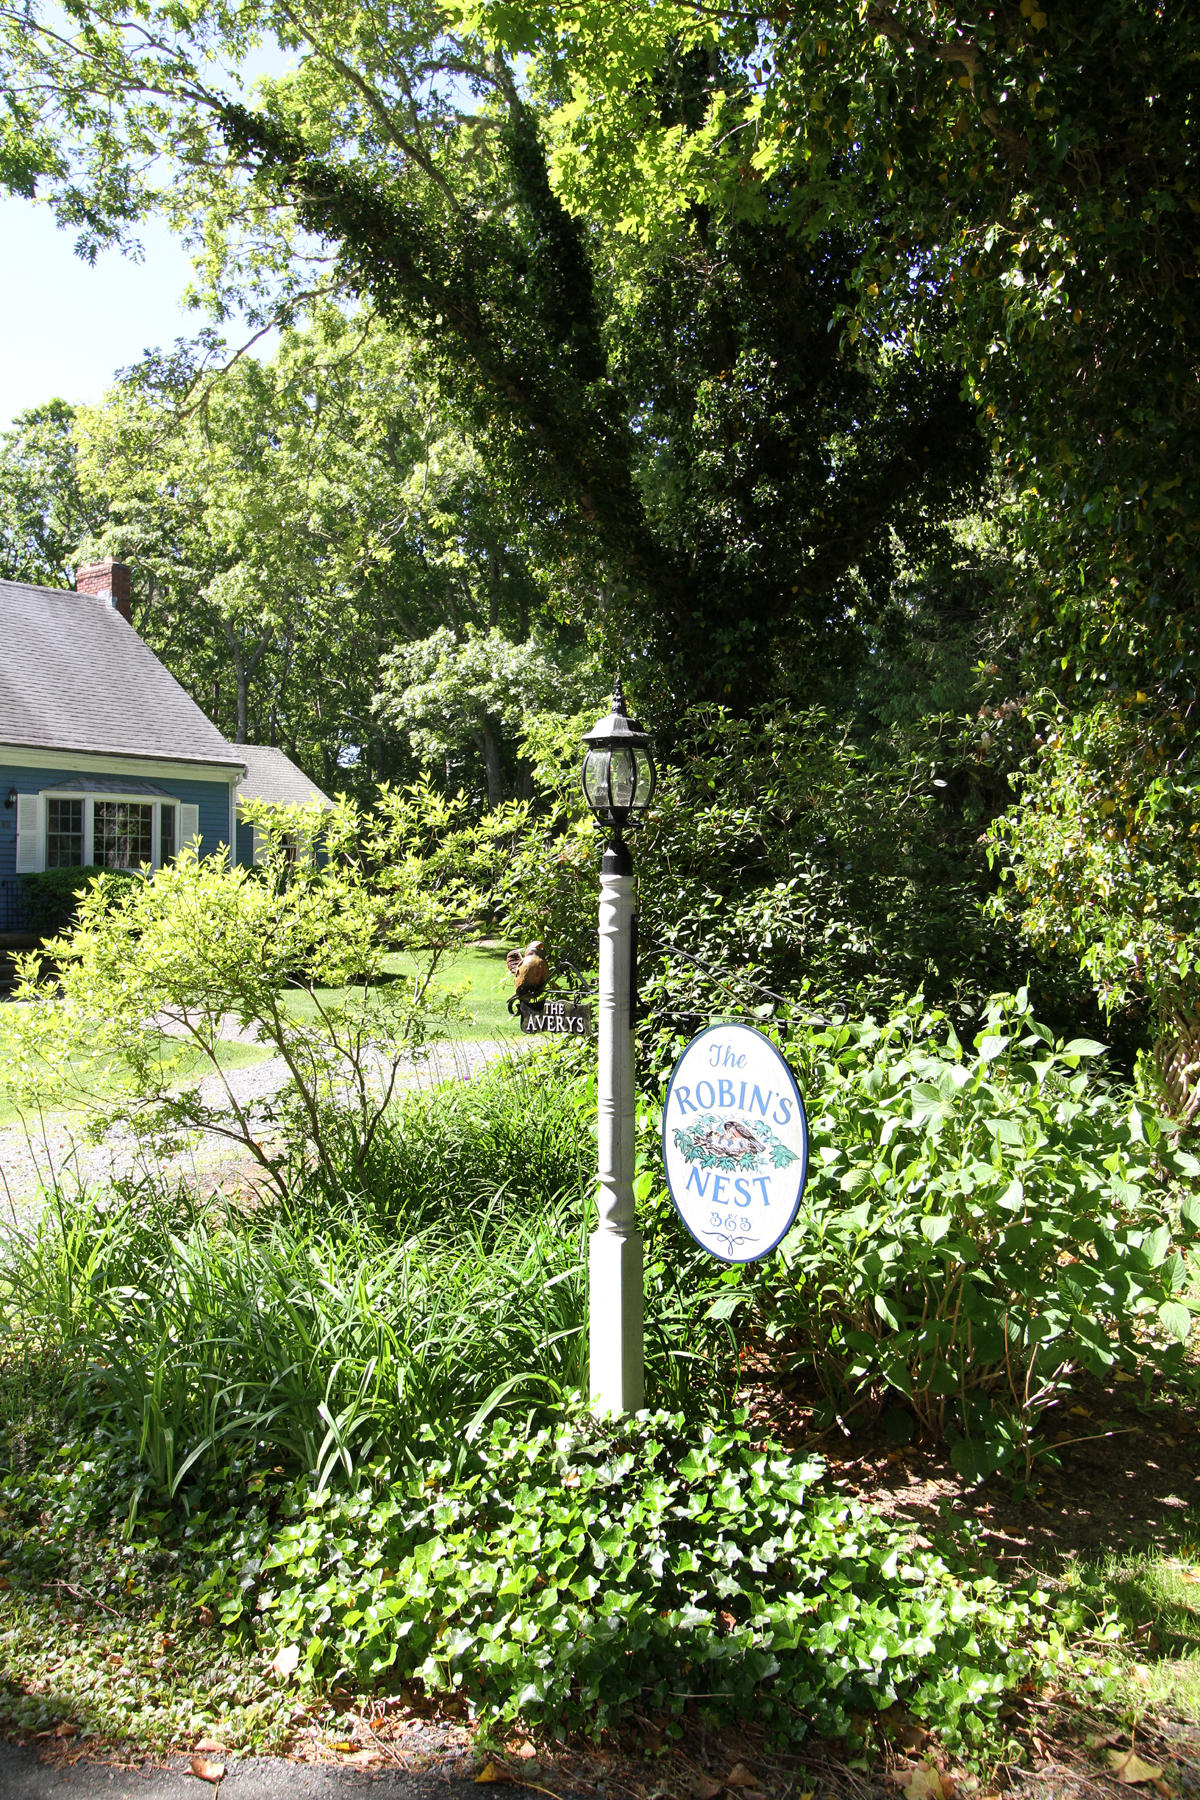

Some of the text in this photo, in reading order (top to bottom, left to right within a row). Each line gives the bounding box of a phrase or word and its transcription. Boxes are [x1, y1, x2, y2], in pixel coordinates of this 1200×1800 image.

[544, 1003, 565, 1015] THE
[526, 1014, 584, 1032] AVERYS
[709, 1043, 747, 1068] The
[674, 1079, 793, 1125] ROBIN'S
[685, 1166, 771, 1207] NEST
